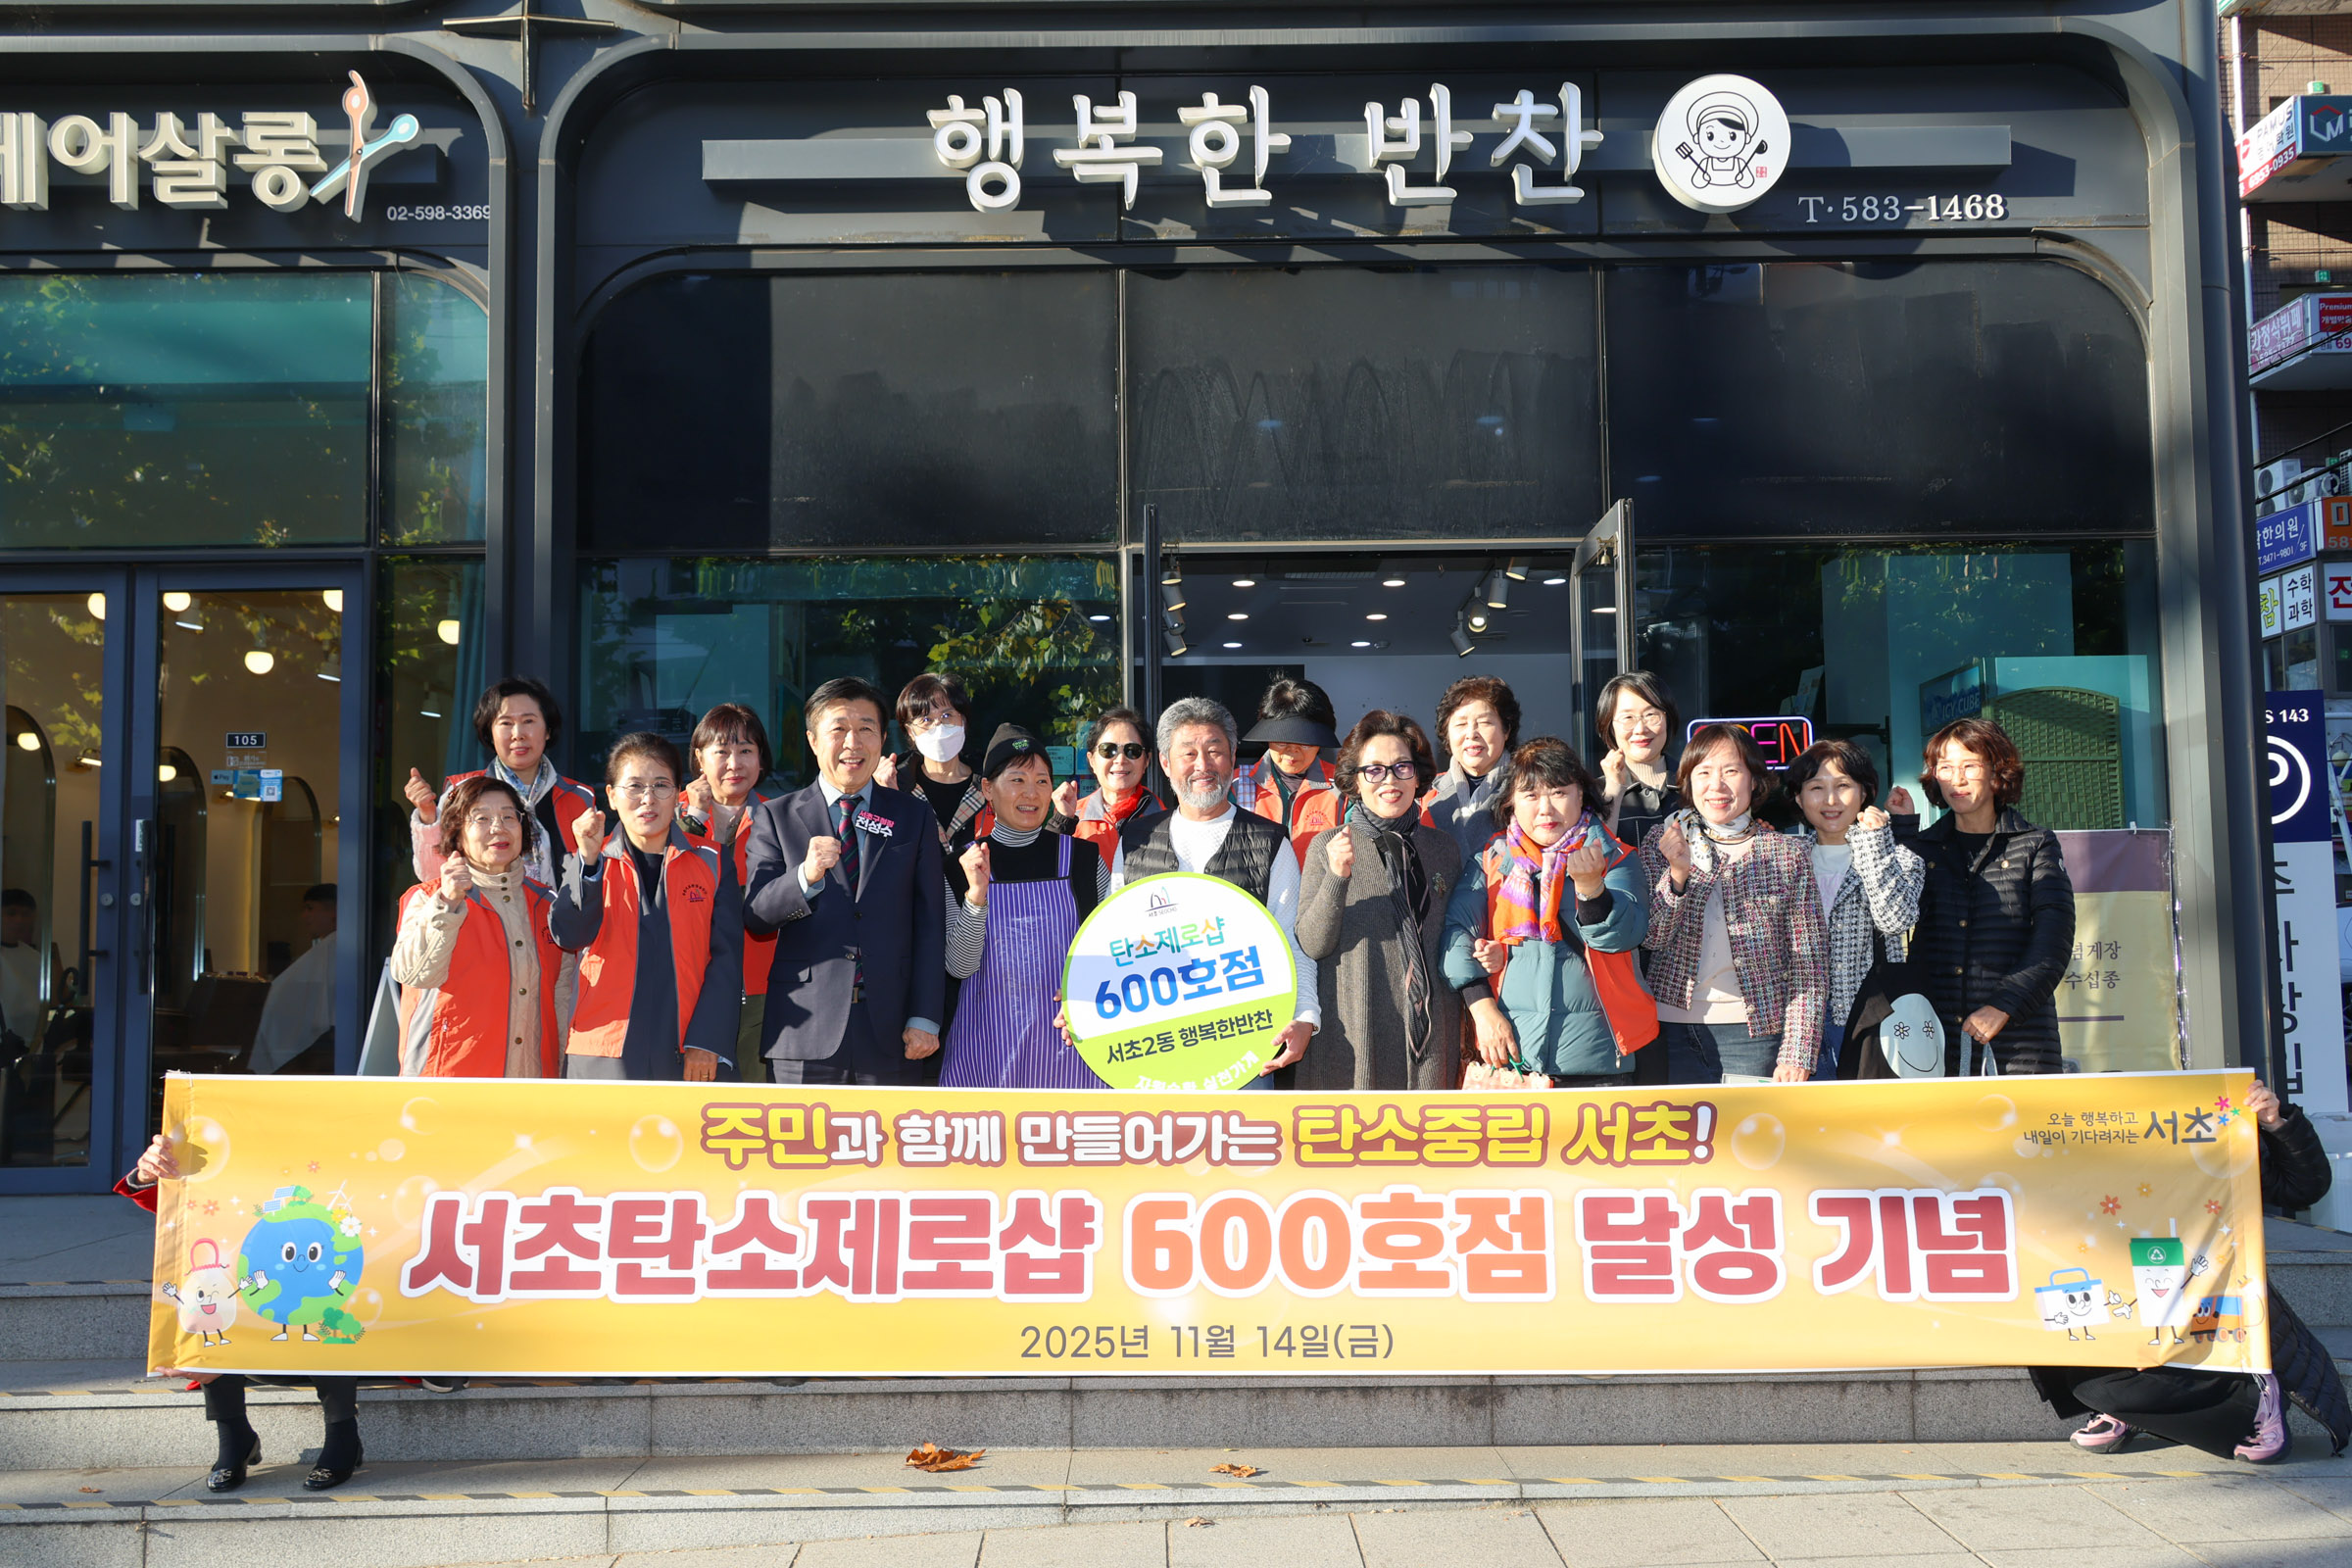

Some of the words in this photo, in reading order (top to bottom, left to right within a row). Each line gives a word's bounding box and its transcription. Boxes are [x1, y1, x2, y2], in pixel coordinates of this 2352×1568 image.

[926, 84, 1292, 214] 행복한
[1364, 81, 1605, 208] 반찬
[386, 204, 490, 221] 02-598-3369
[2287, 572, 2313, 599] 수학
[2288, 598, 2314, 622] 과학
[2278, 708, 2310, 723] 143
[234, 735, 258, 746] 105
[855, 815, 893, 838] 전성수
[1109, 916, 1225, 967] 탄소제로샵
[1096, 945, 1265, 1019] 600호점
[1107, 1031, 1176, 1064] 서초2동
[1178, 1008, 1274, 1048] 행복한반찬
[2047, 1112, 2076, 1127] 오늘
[2081, 1110, 2139, 1127] 행복하고
[2143, 1106, 2218, 1146] 서초
[703, 1104, 887, 1168] 주민과
[897, 1111, 1004, 1166] 함께
[1018, 1111, 1280, 1166] 만들어가는
[1296, 1104, 1545, 1166] 탄소중립
[1563, 1102, 1716, 1165] 서초!
[2023, 1130, 2066, 1146] 내일이
[2071, 1129, 2140, 1145] 기다려지는
[405, 1191, 1099, 1299] 서초탄소제로샵
[1127, 1190, 1551, 1297] 600호점
[1579, 1192, 1782, 1298] 달성
[1813, 1192, 2014, 1297] 기념
[1020, 1324, 1150, 1358] 2025년
[1170, 1324, 1236, 1358] 11월
[1256, 1323, 1395, 1359] 14일(금)
